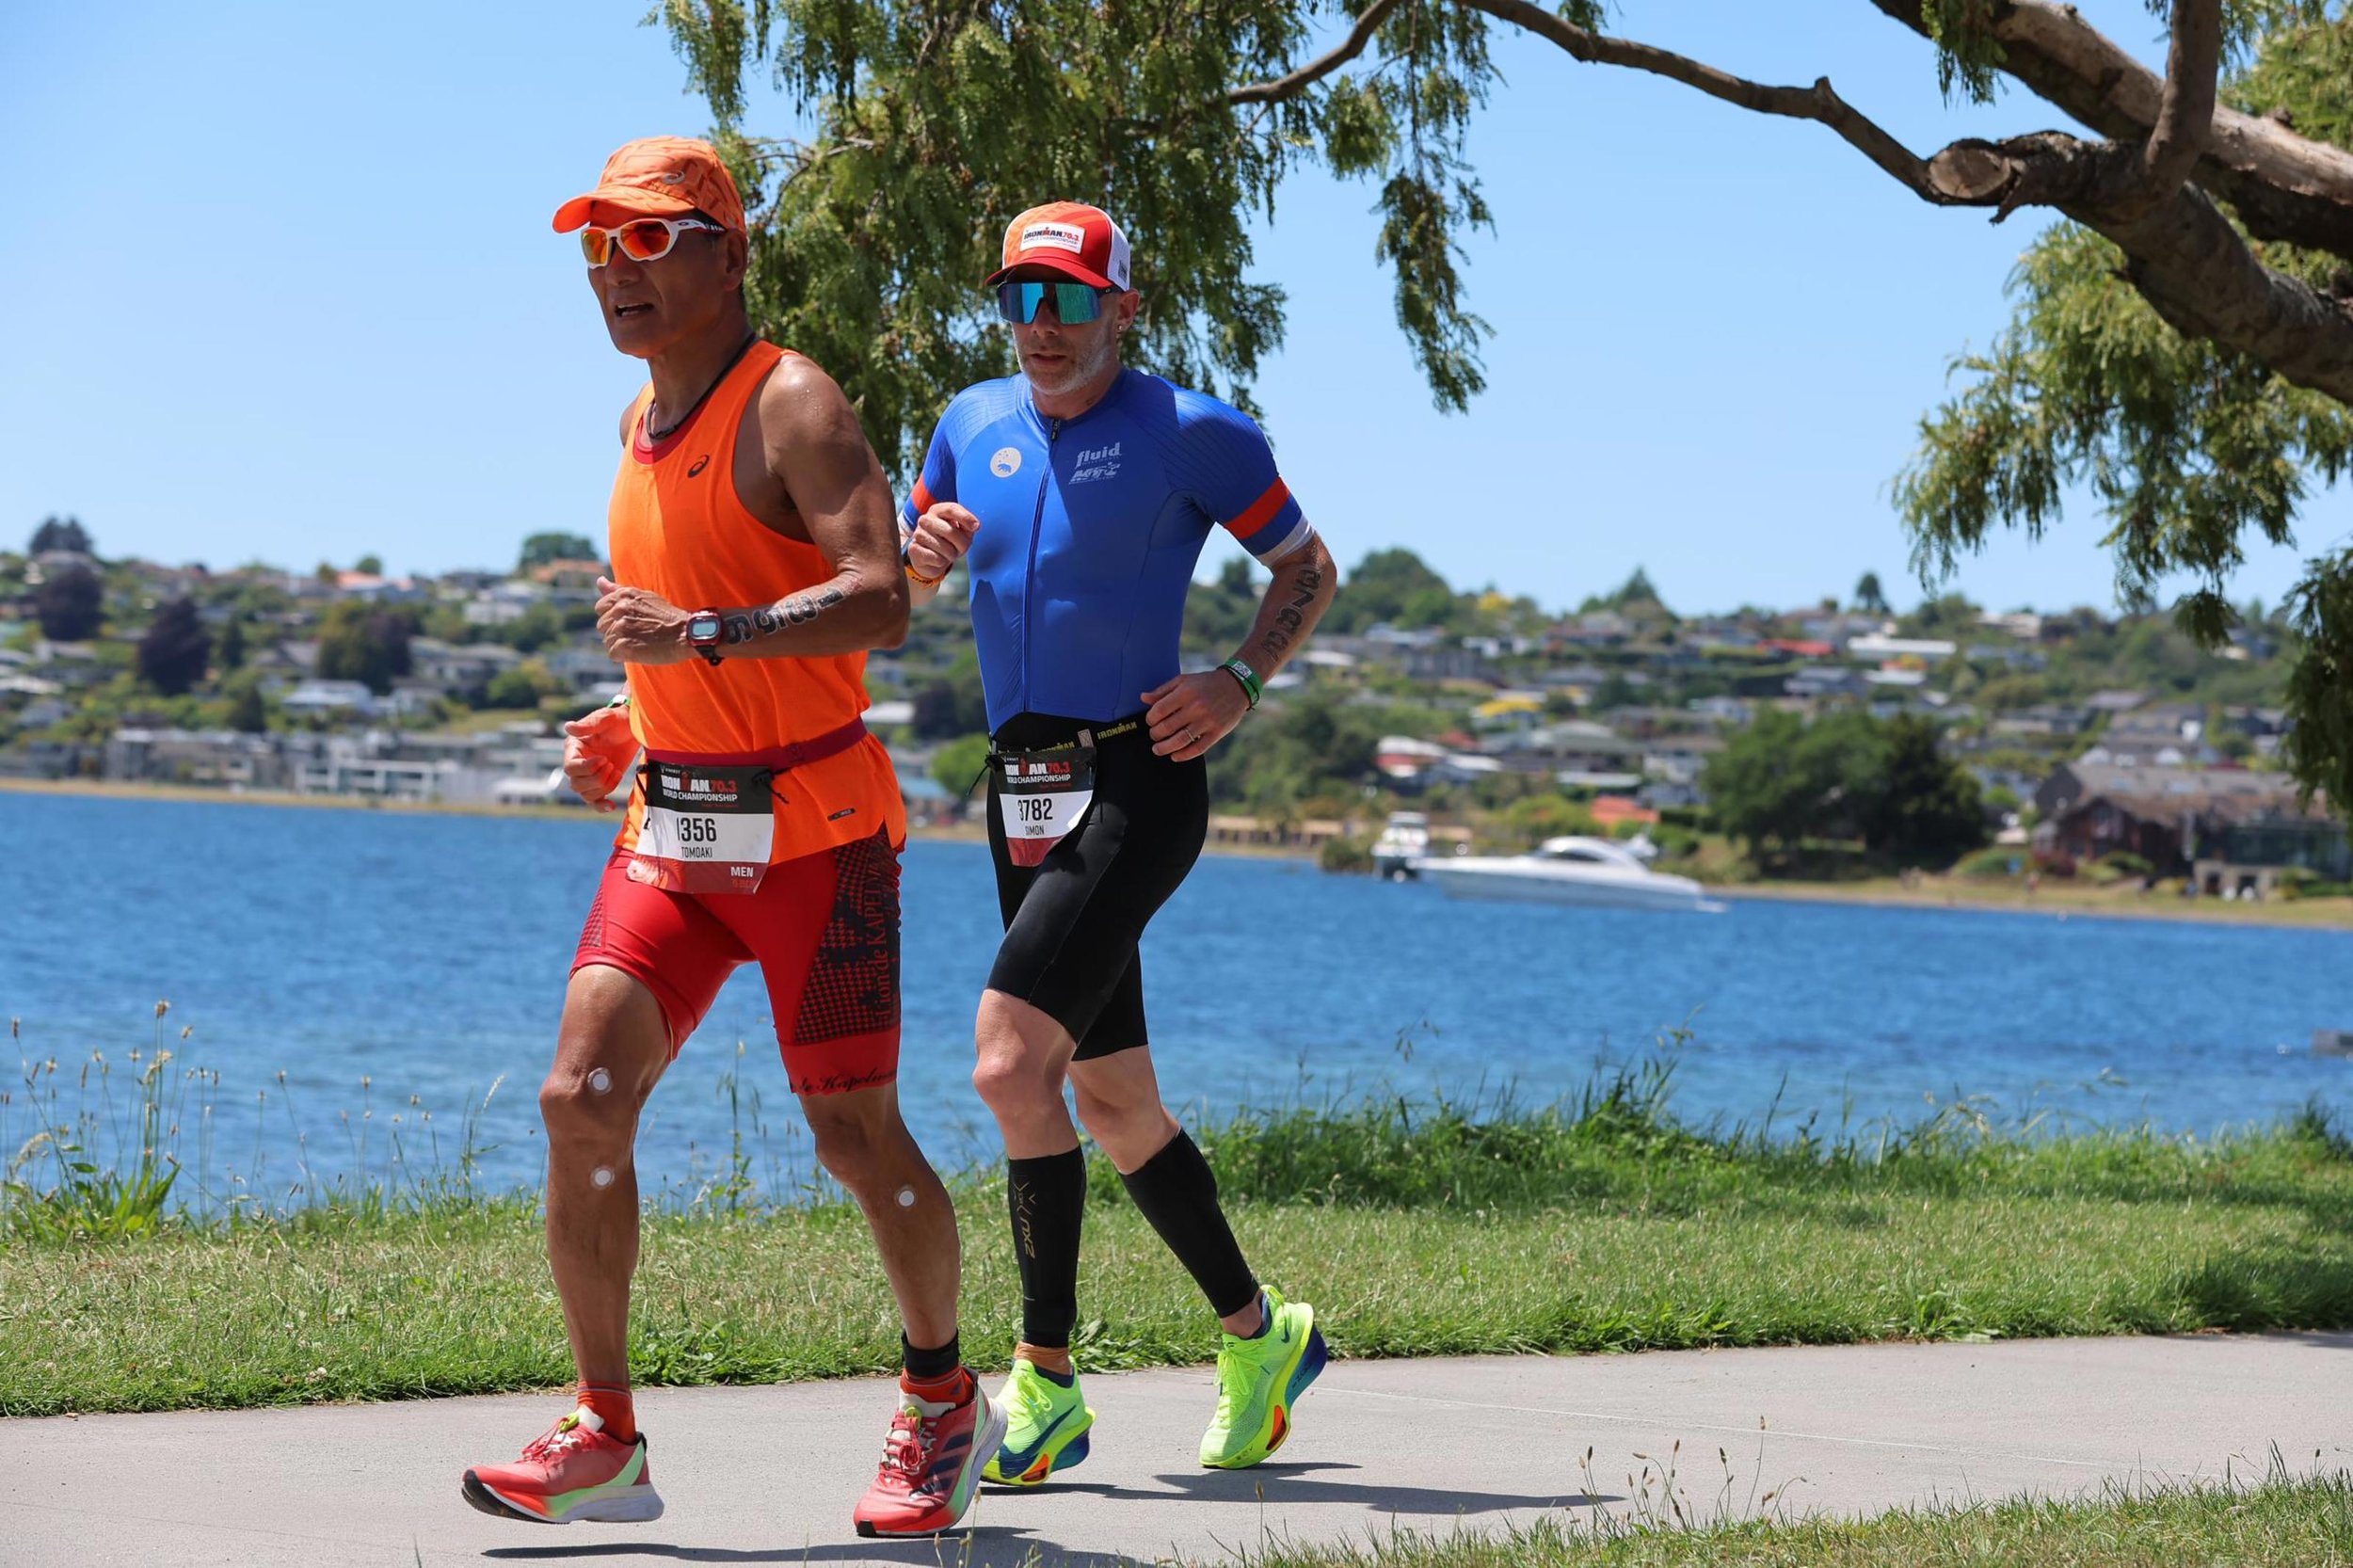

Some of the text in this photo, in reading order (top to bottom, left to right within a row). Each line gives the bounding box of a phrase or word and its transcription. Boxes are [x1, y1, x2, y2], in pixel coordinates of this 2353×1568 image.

[1075, 442, 1121, 469] fluid
[1097, 721, 1138, 740] IRONMAN
[1017, 775, 1071, 784] CHAMPIONSHIP
[678, 792, 738, 802] CHAMPIONSHIP
[1017, 798, 1053, 822] 3782
[1025, 824, 1045, 836] SIMON
[680, 846, 713, 858] TOMOAKI
[730, 866, 754, 877] MEN
